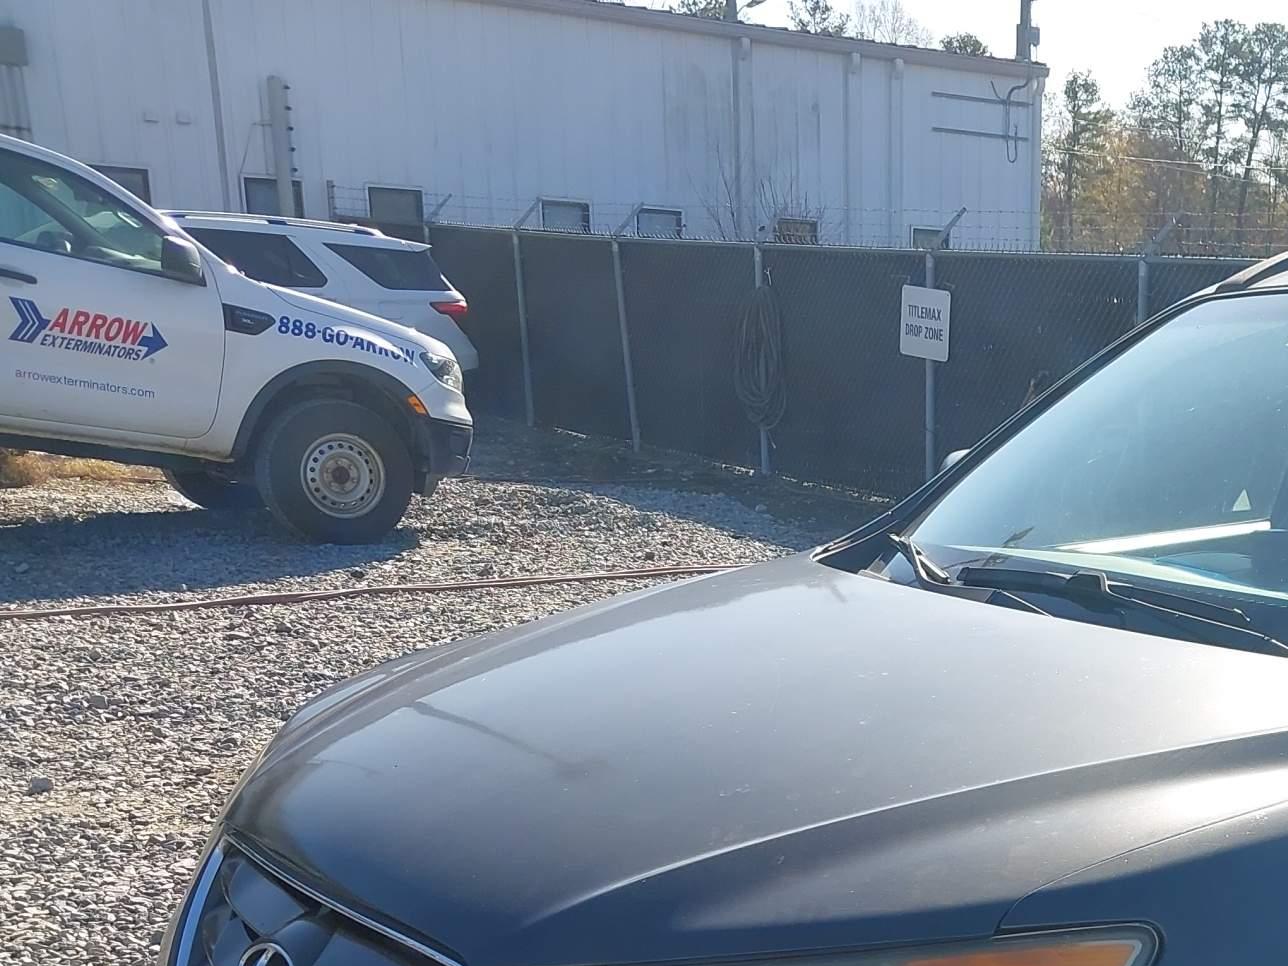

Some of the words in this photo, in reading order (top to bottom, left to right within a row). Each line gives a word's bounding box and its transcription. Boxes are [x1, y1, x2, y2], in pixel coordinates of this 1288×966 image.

[49, 307, 149, 345] ARROW
[908, 304, 942, 321] TITLEMAX
[905, 323, 923, 338] DROP
[924, 326, 944, 342] ZONE
[40, 333, 143, 361] EXTERMINATORS
[15, 368, 155, 398] arrowexterminators.com
